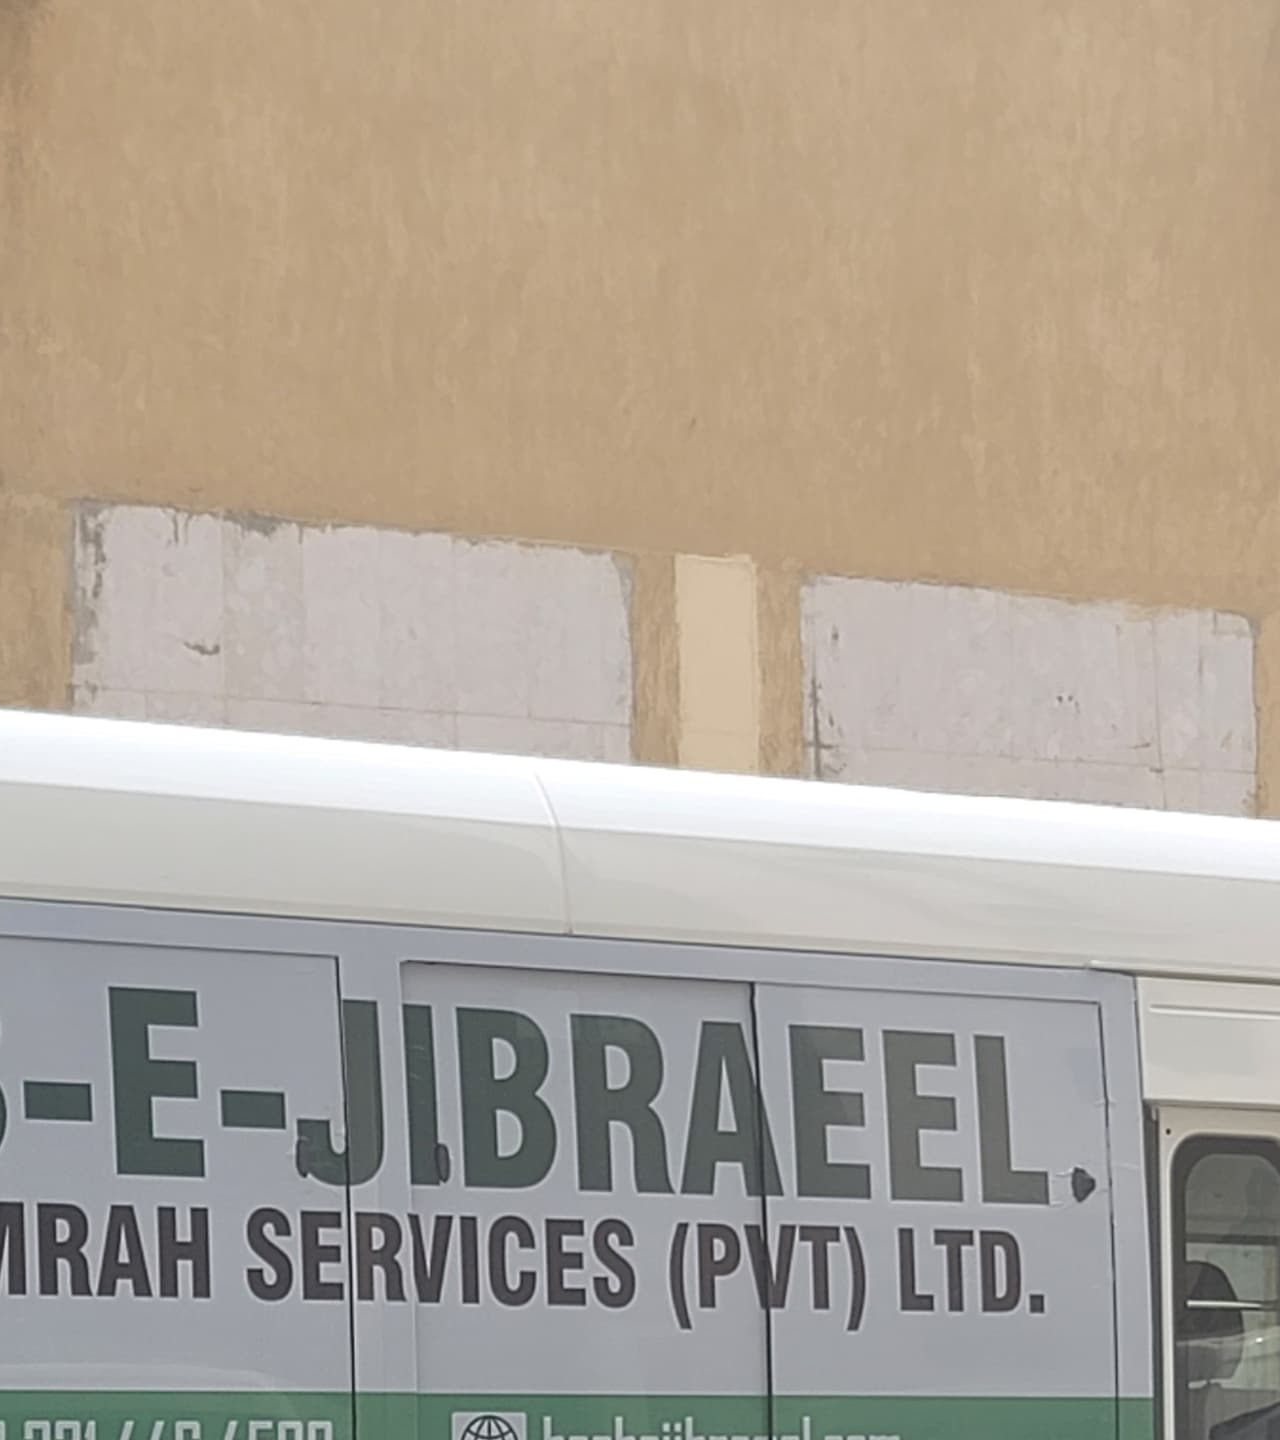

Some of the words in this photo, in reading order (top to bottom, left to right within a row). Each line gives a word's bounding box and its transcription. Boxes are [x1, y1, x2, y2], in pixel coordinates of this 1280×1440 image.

[246, 1208, 635, 1308] SERVICES
[669, 1222, 865, 1331] (PVT)
[898, 1228, 1045, 1314] LTD.
